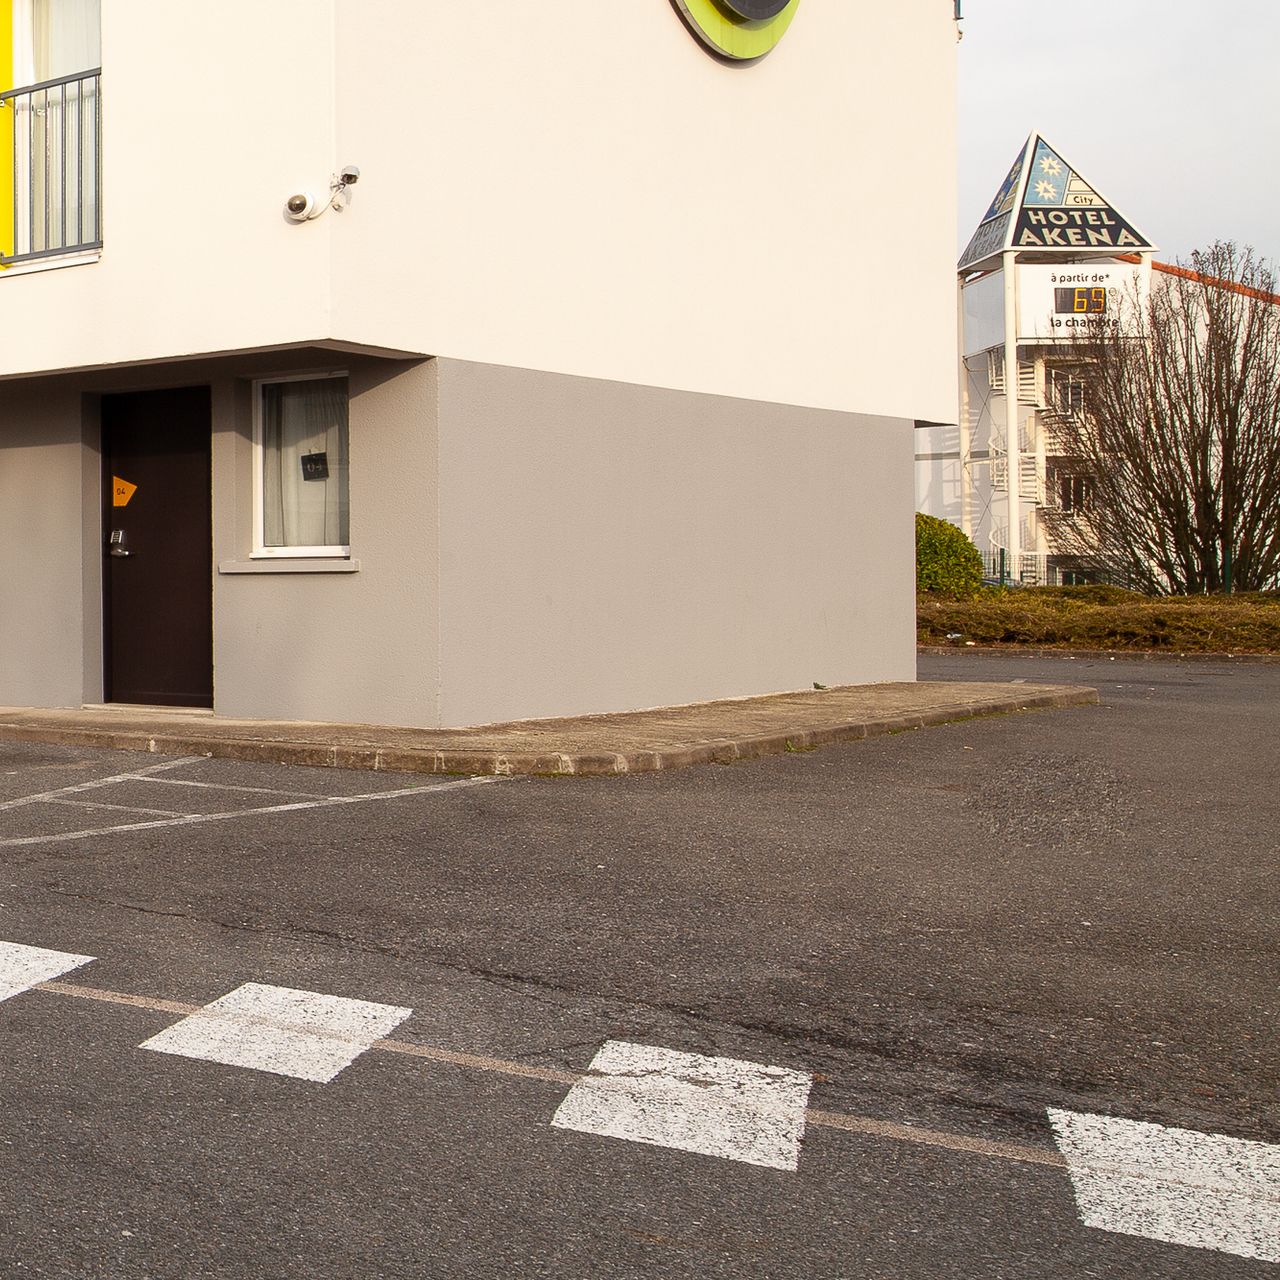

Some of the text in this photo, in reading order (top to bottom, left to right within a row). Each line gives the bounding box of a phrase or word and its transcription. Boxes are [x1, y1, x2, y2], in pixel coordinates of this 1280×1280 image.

[1073, 195, 1094, 206] City
[1027, 210, 1116, 225] HOTEL
[1019, 227, 1142, 246] AKENA
[1059, 273, 1089, 284] partir
[1073, 287, 1105, 312] 69
